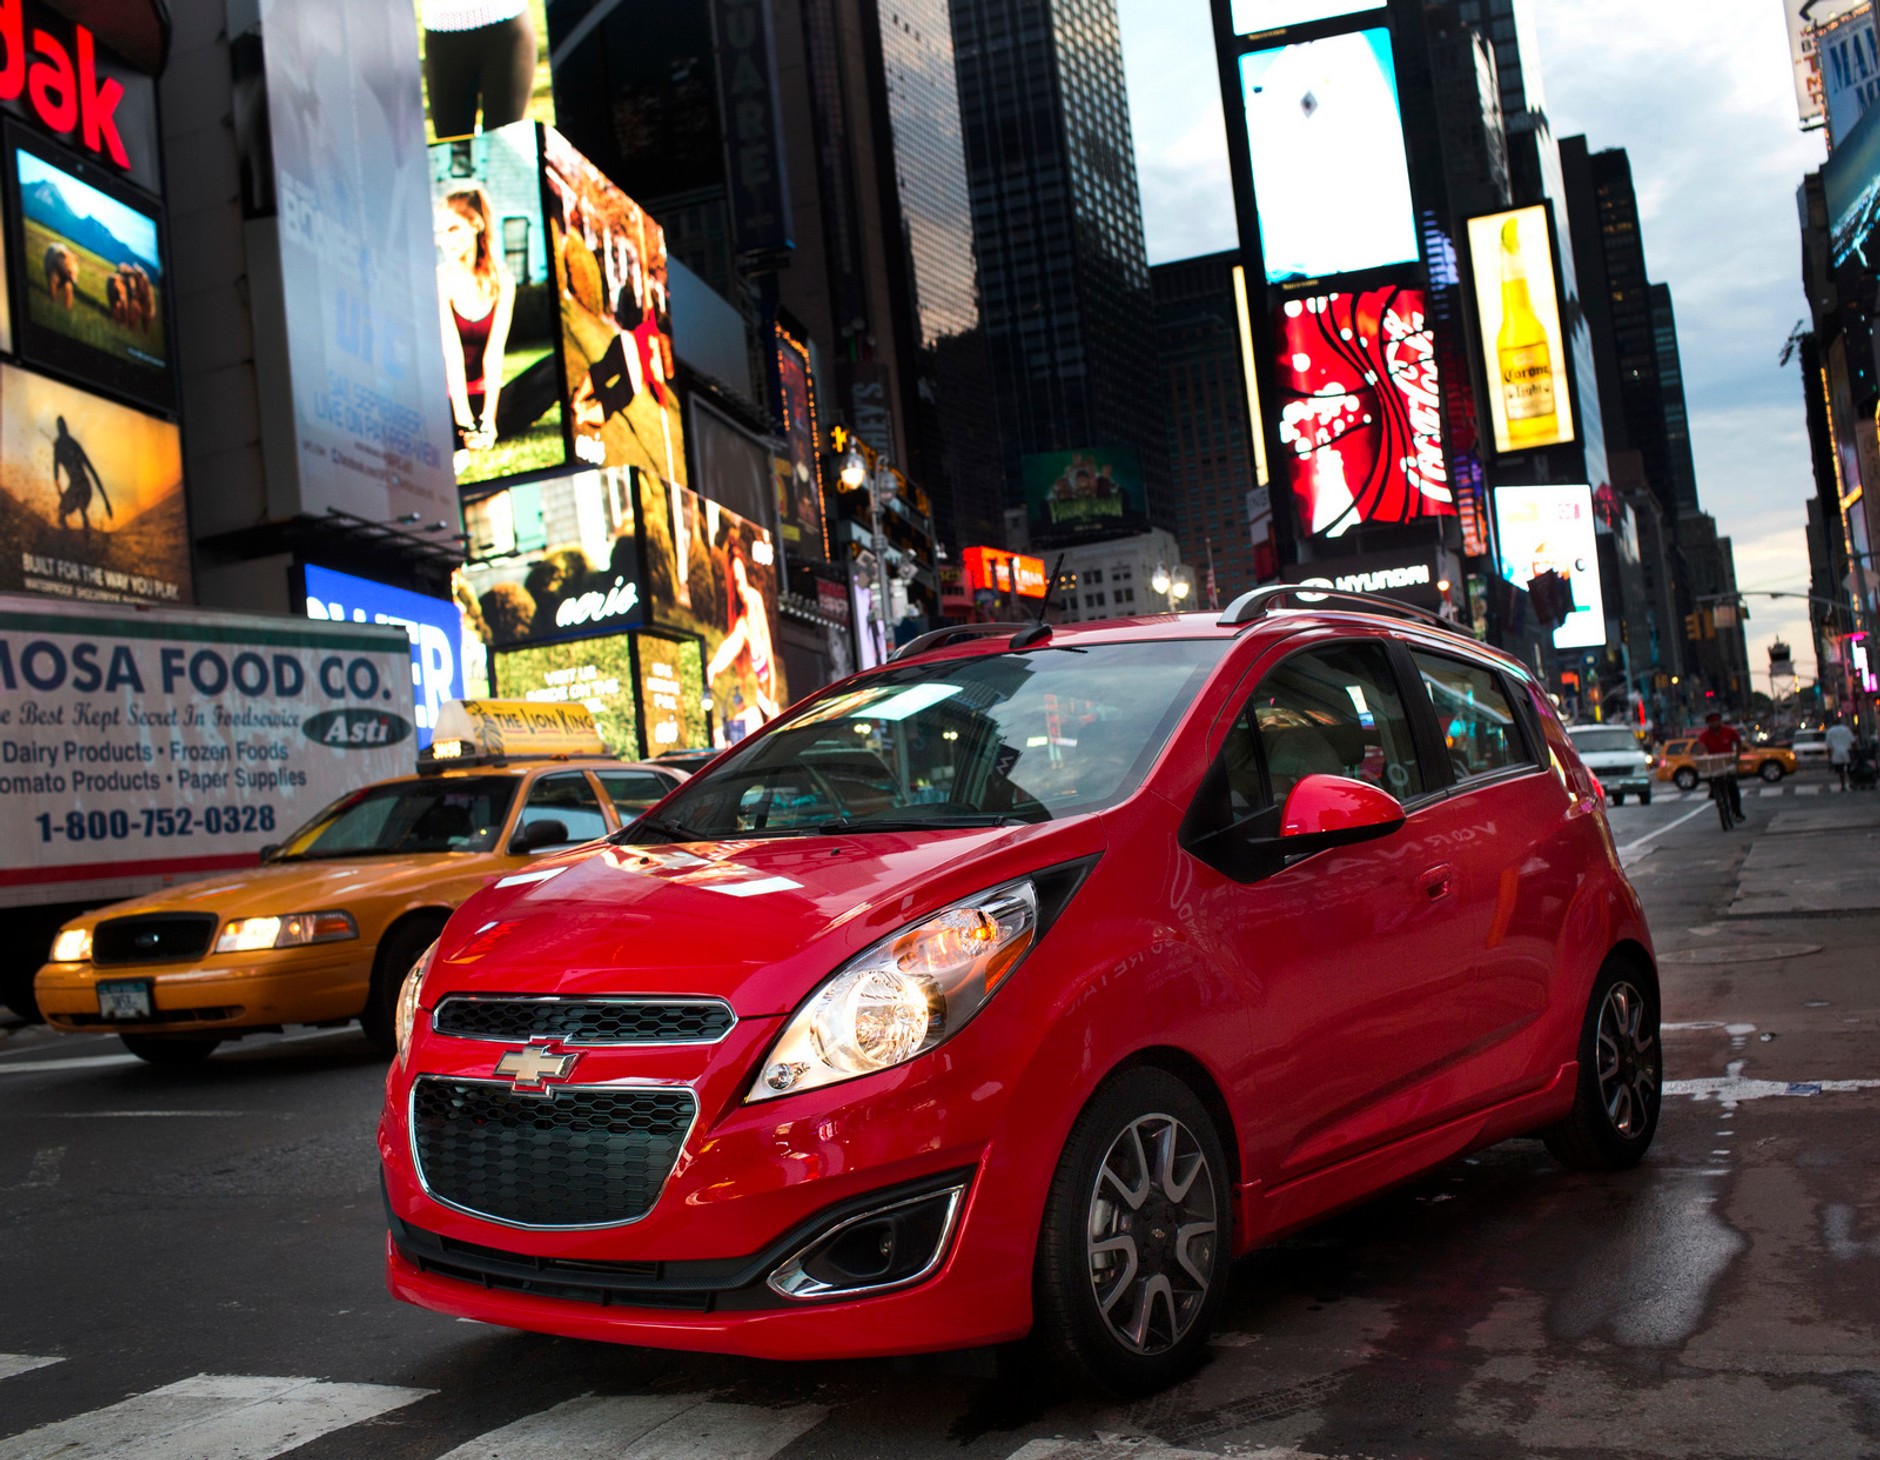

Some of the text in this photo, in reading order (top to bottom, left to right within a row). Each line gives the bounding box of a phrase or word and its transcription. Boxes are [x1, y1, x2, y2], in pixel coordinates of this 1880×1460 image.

[722, 0, 771, 186] UARE
[22, 552, 54, 576] BUILT
[57, 560, 81, 582] FOR
[82, 565, 104, 587] THE
[130, 573, 154, 596] YOU
[1335, 564, 1430, 593] HYUNDAI
[160, 647, 305, 698] FOOD
[319, 656, 392, 700] CO.
[20, 701, 63, 726] Best
[72, 702, 119, 733] Kept
[127, 703, 177, 727] Secret
[182, 704, 206, 727] In
[212, 704, 300, 728] Foodservice
[323, 716, 391, 743] Asti
[3, 741, 290, 768] Dairy Products Frozen Foods
[72, 769, 161, 793] Products
[178, 768, 229, 795] Paper
[235, 766, 308, 793] Supplies
[35, 804, 276, 843] 1-800-752-0328
